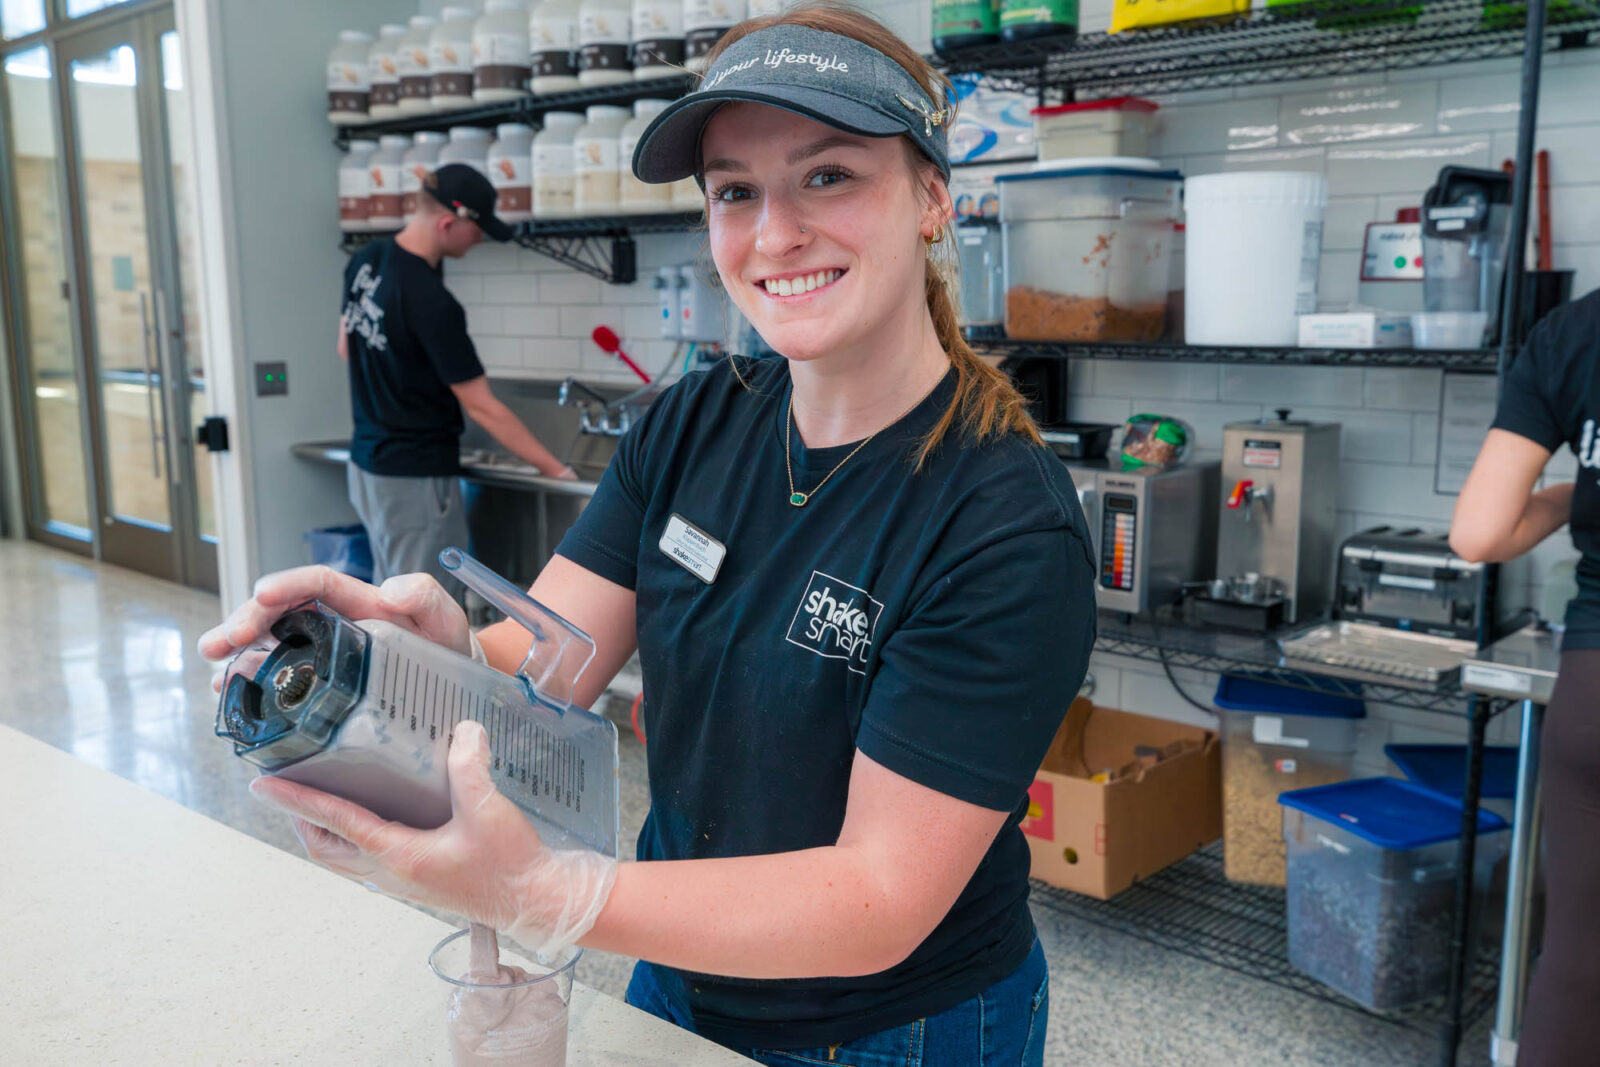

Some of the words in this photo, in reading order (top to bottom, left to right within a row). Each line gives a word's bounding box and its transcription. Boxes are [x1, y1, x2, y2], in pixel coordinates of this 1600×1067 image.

[715, 57, 760, 86] your
[763, 48, 848, 73] lifestyle
[684, 526, 710, 548] Savannah
[804, 586, 869, 636] shake
[805, 616, 872, 662] smart
